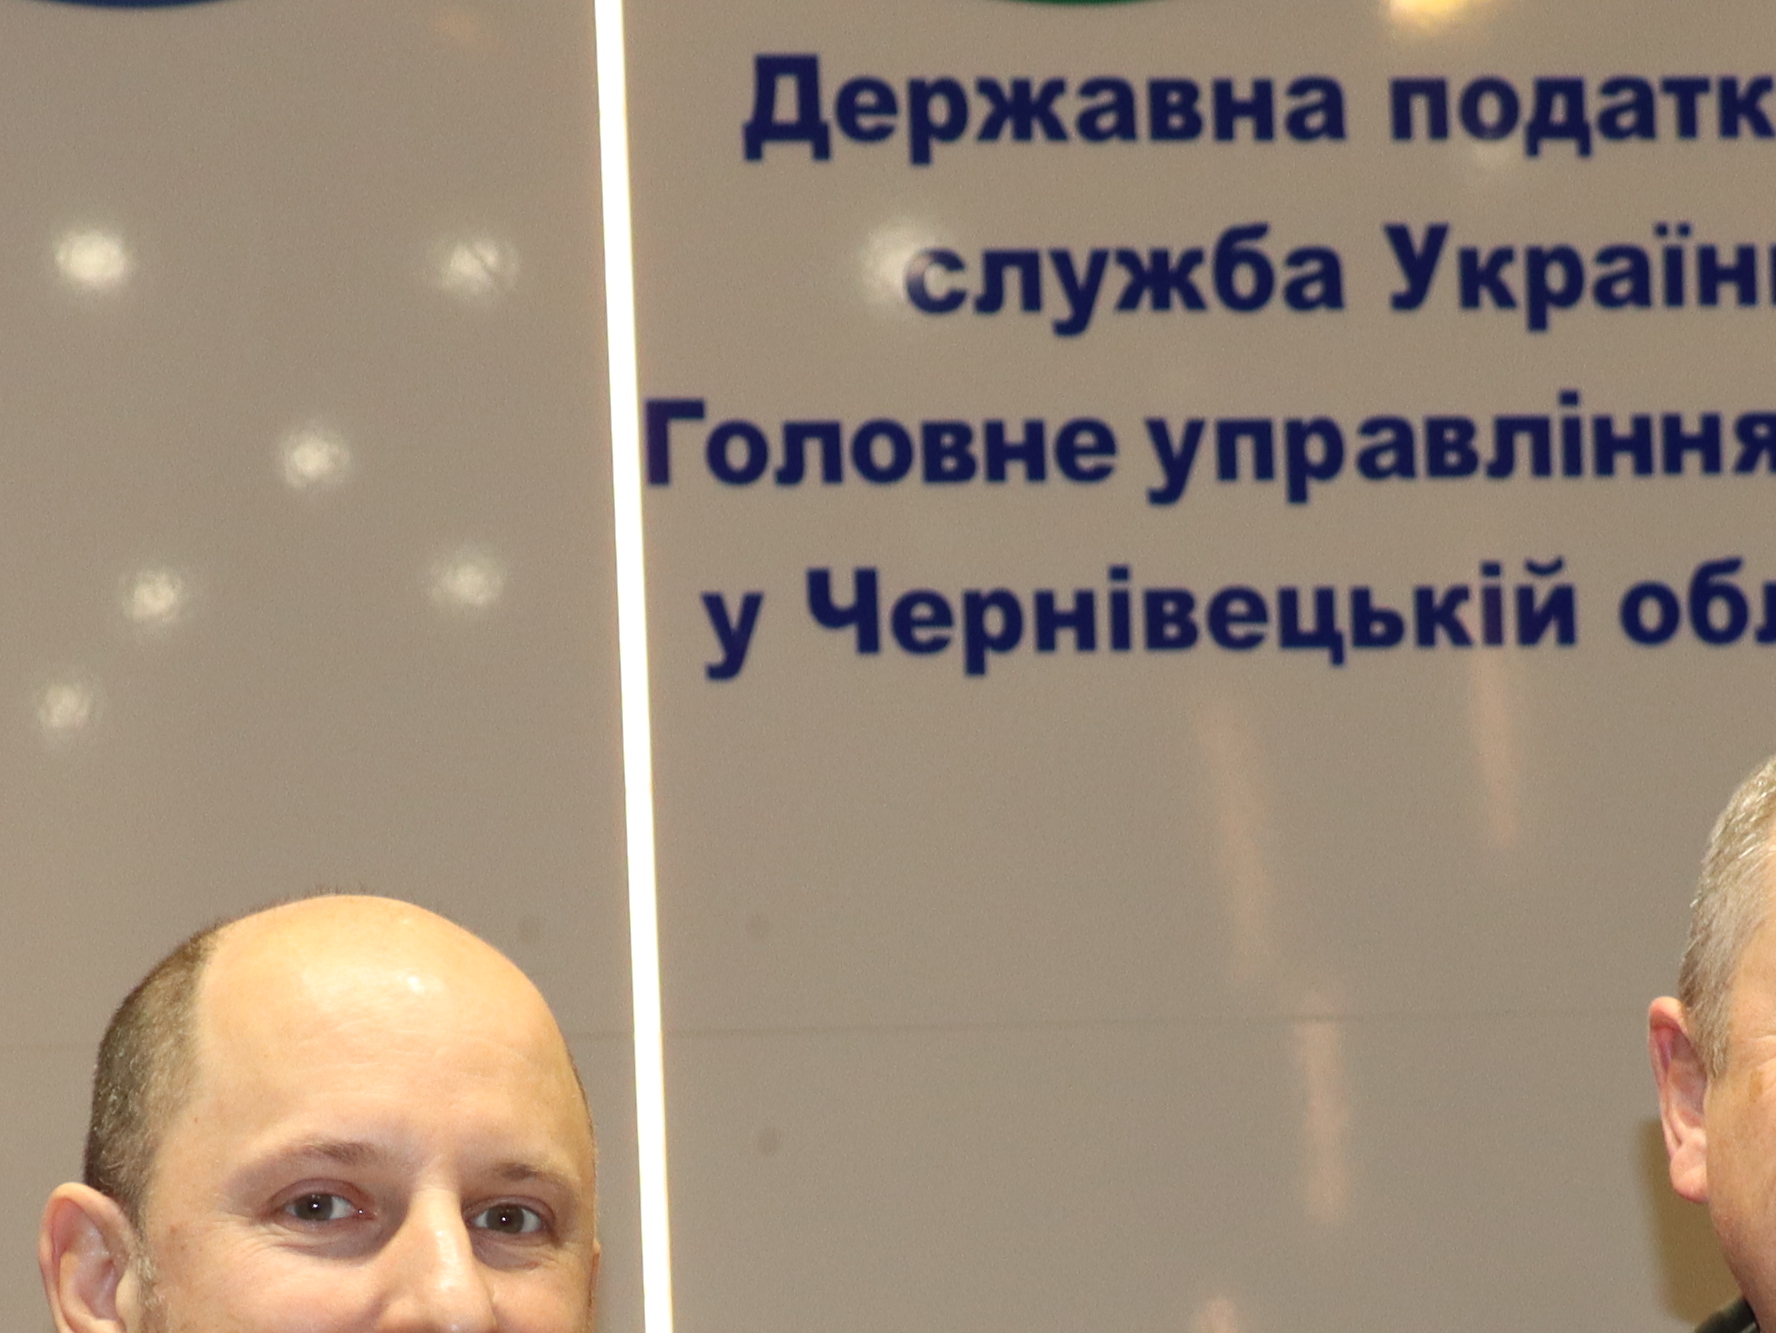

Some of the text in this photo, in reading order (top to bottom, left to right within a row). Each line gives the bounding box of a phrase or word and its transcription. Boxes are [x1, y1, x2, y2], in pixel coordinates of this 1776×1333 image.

[742, 54, 1346, 165] Державна
[901, 222, 1345, 337] служба
[642, 399, 1120, 488] Головне
[701, 590, 765, 681] у
[804, 561, 1580, 676] Чернівецькій
